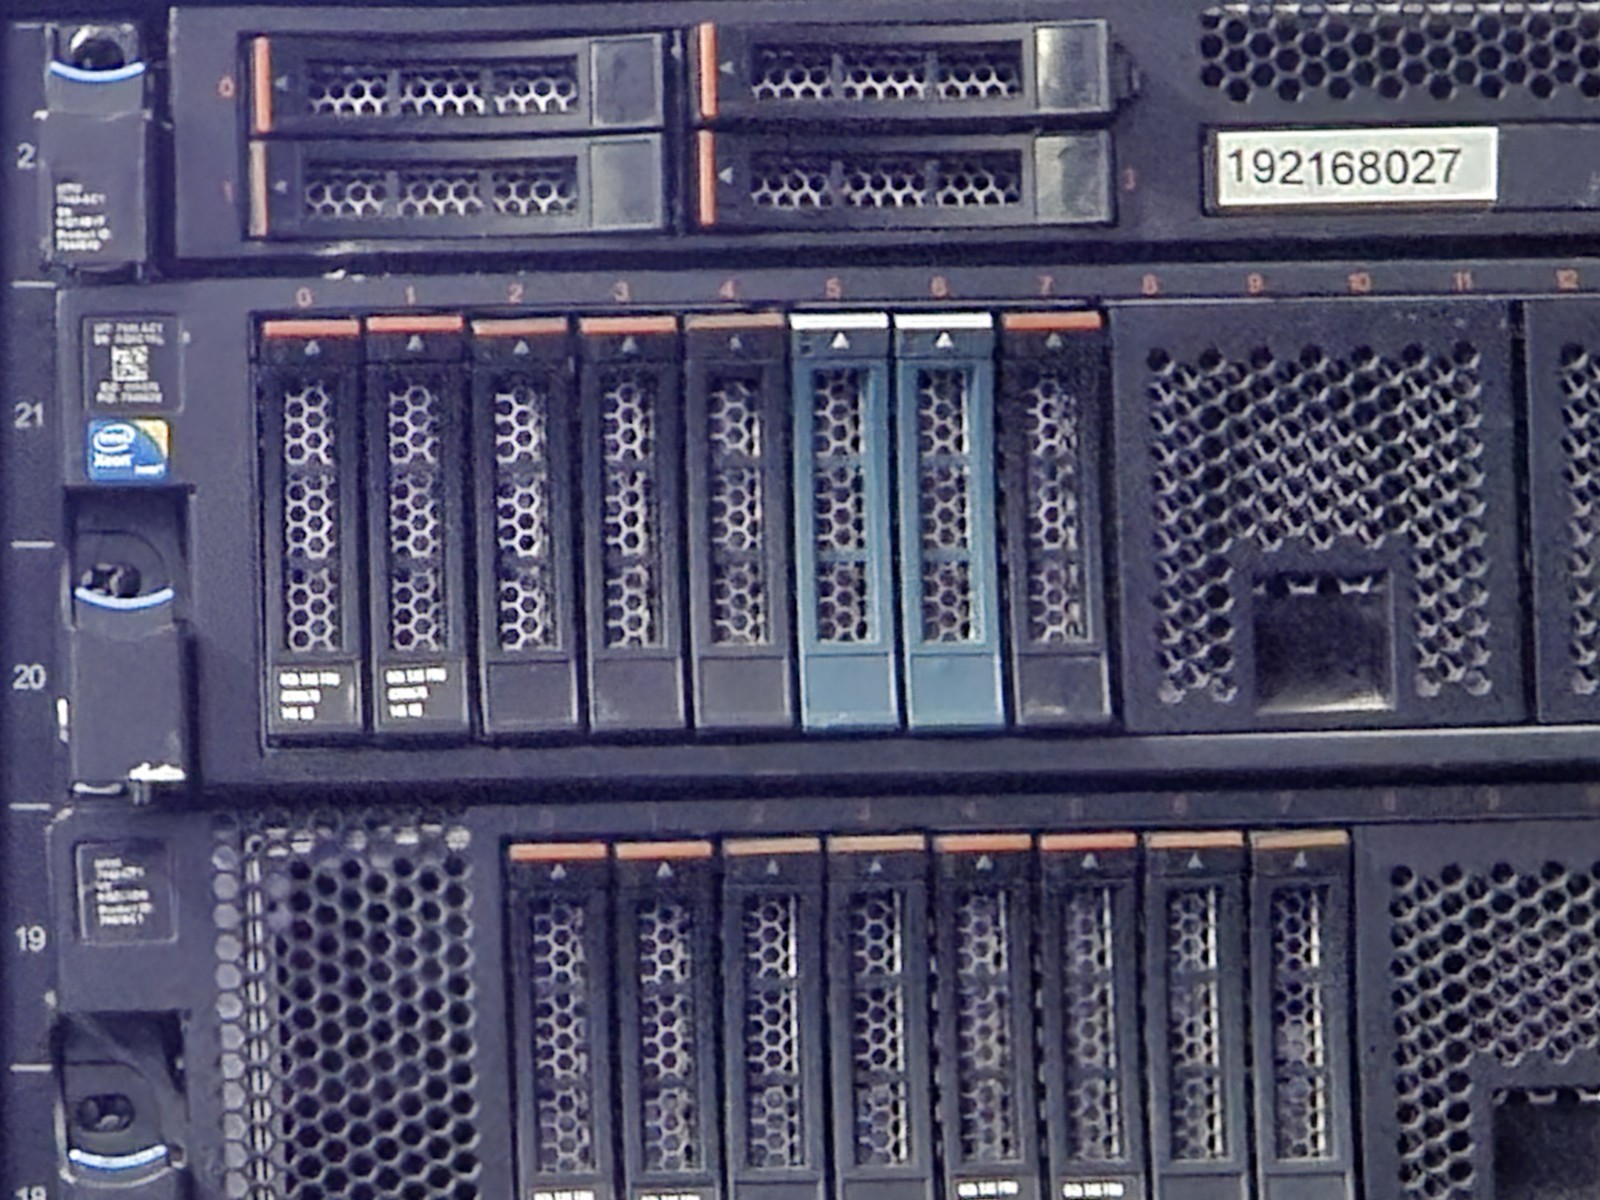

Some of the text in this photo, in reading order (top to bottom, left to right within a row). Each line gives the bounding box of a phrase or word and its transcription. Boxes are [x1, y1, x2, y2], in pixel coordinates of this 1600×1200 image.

[1228, 148, 1461, 185] 192168027
[296, 287, 312, 306] 0
[406, 284, 416, 305] 1
[508, 283, 524, 303] 2
[614, 281, 629, 302] 3
[719, 279, 735, 298] 4
[826, 277, 841, 299] 5
[1039, 275, 1053, 296] 7
[1247, 271, 1263, 293] 9
[1347, 271, 1371, 292] 10
[1454, 269, 1473, 291] 11
[15, 401, 44, 428] 21
[13, 663, 46, 690] 20
[15, 925, 46, 952] 19
